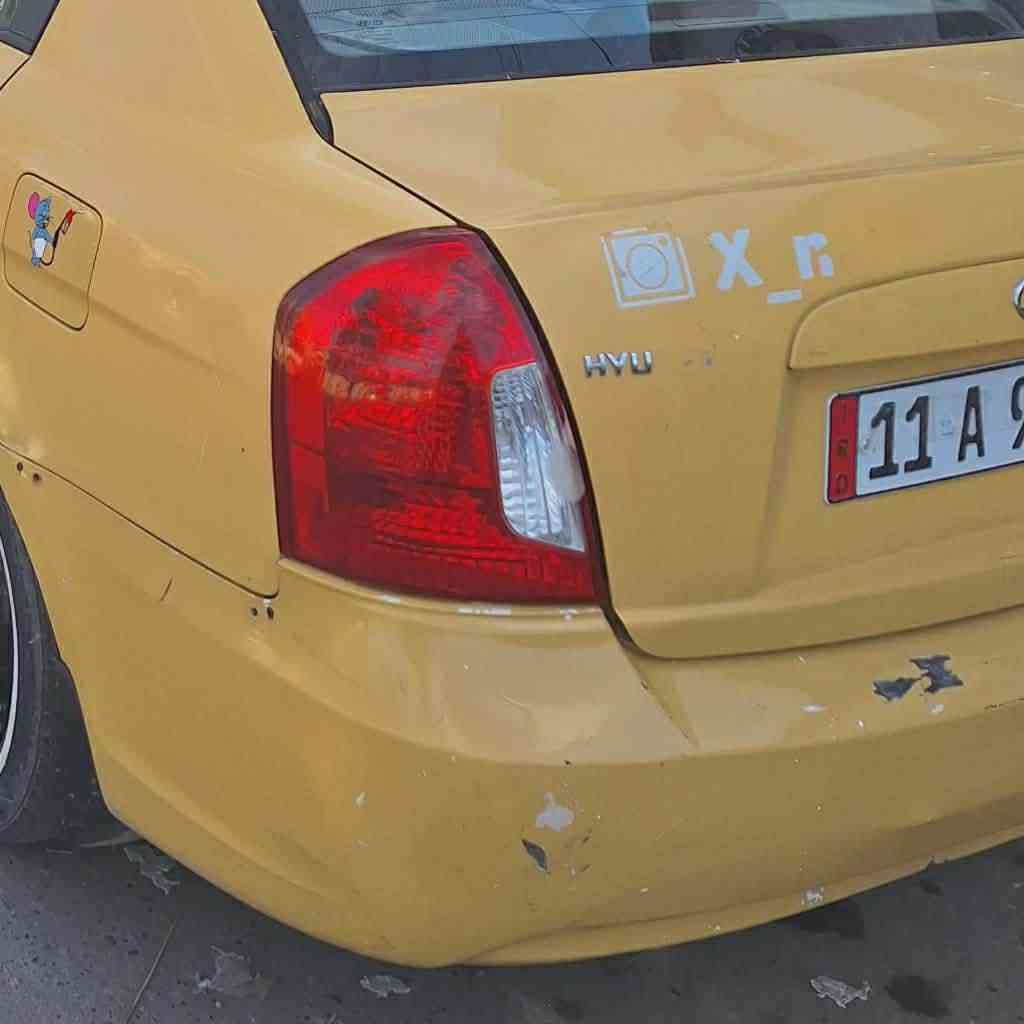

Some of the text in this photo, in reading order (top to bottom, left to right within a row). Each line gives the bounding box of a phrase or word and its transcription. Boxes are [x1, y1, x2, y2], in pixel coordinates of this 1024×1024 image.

[584, 351, 652, 377] HYU
[869, 395, 933, 480] 11
[958, 385, 985, 462] A
